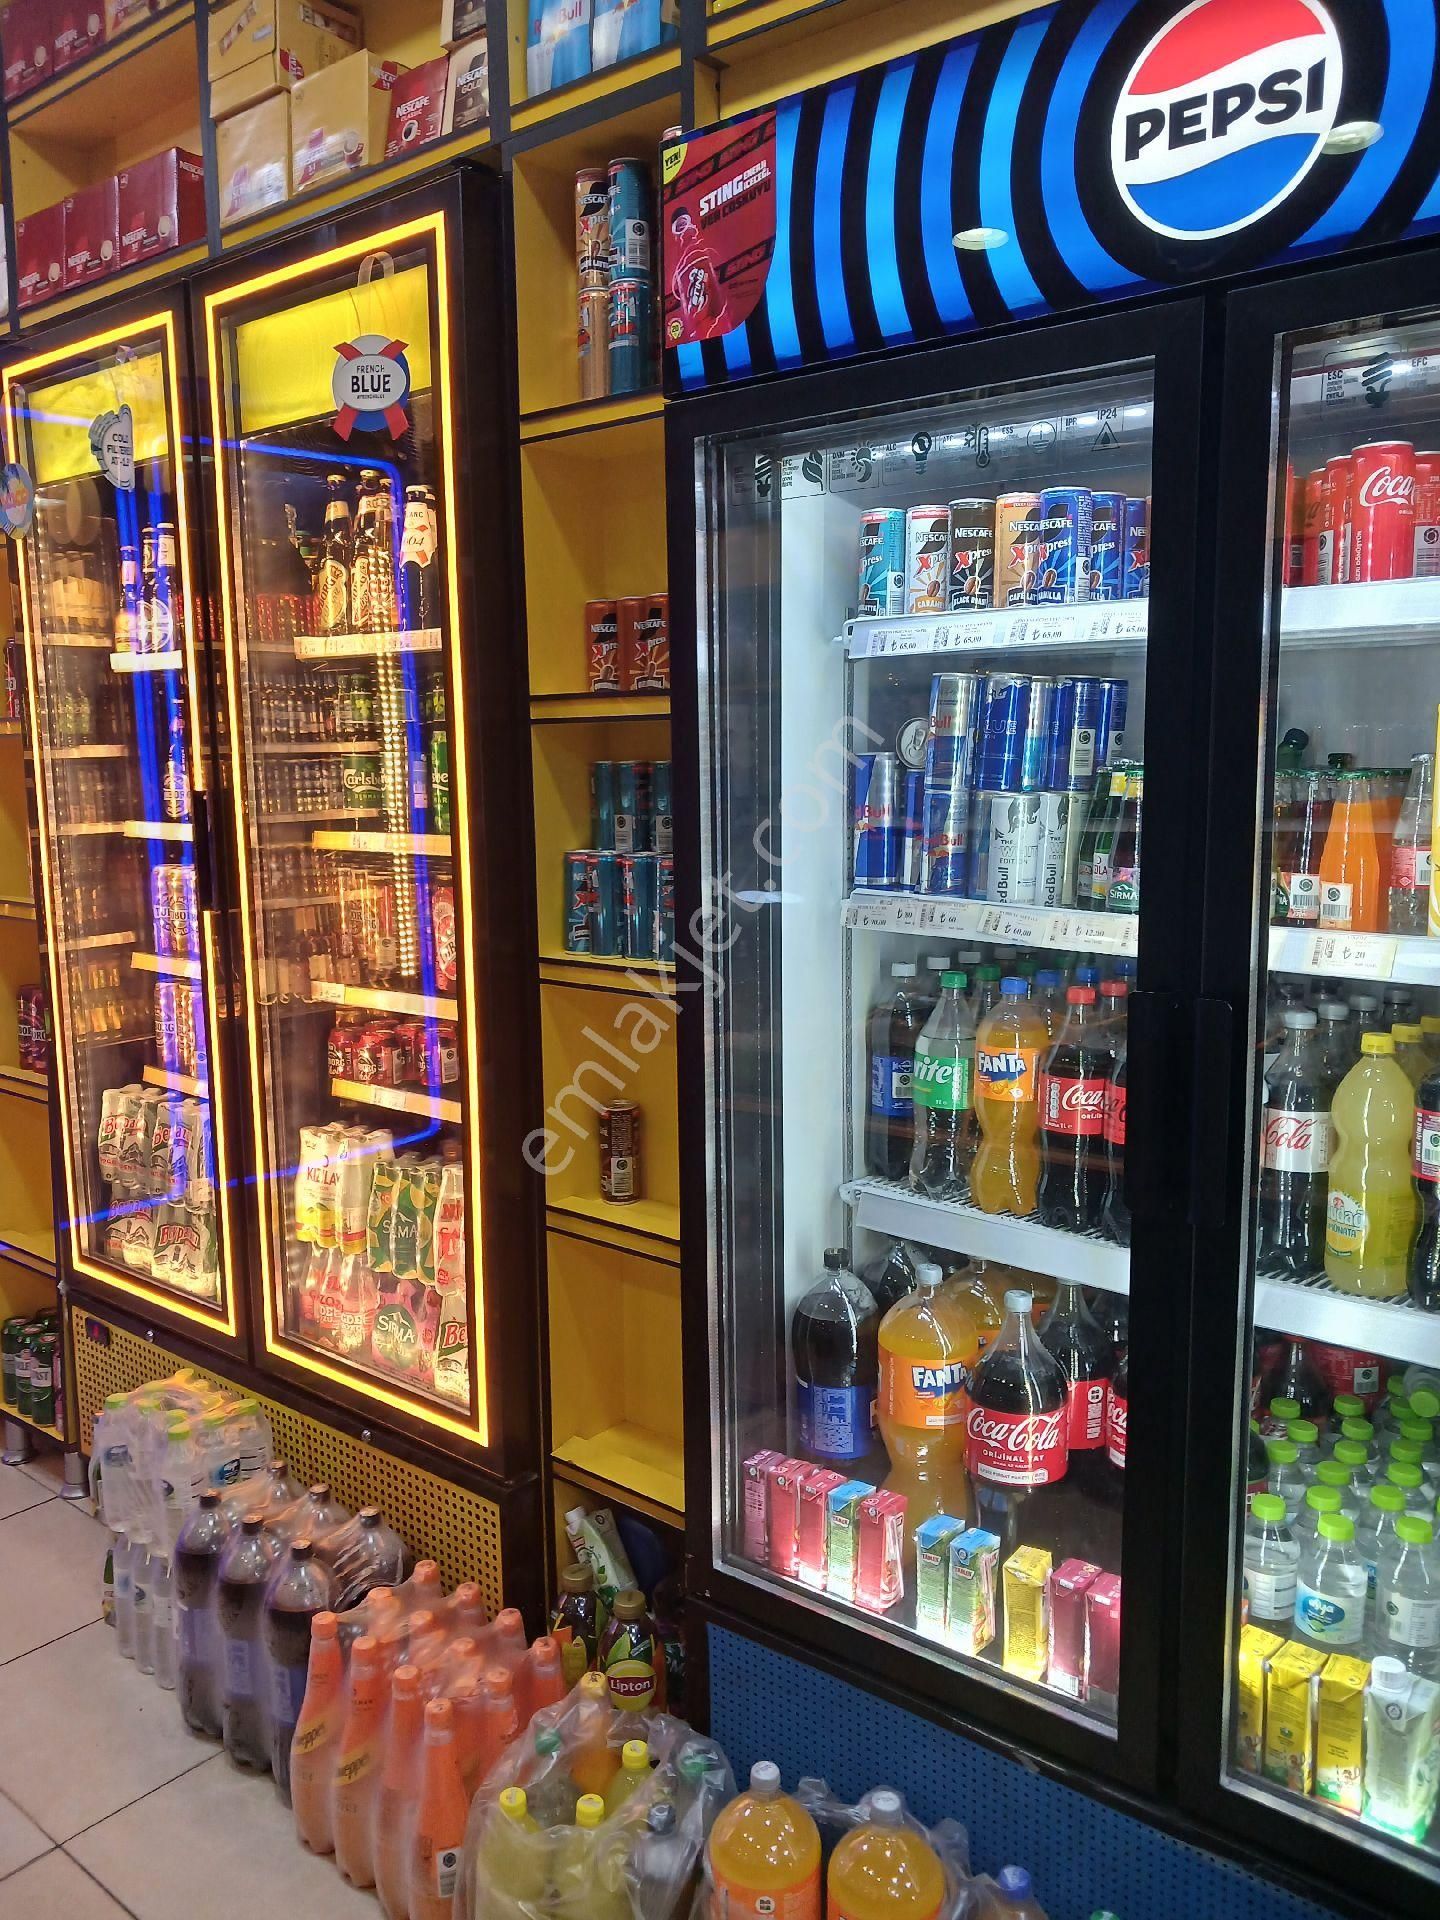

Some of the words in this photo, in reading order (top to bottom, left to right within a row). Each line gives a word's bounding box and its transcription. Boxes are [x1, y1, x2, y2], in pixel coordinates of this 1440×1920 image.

[461, 78, 483, 94] GOLD
[1125, 56, 1327, 163] PEPSI
[699, 175, 744, 217] STING
[356, 364, 385, 374] FRENCH
[1411, 356, 1428, 368] EFC
[351, 374, 391, 393] BLUE
[1327, 369, 1344, 381] ESC
[1097, 407, 1118, 421] IP24
[930, 715, 951, 728] Bull
[977, 1052, 1026, 1074] FANTA
[1264, 1116, 1318, 1151] Cola
[911, 1363, 967, 1389] FANTA
[967, 1407, 1064, 1452] Coca-Cola
[610, 1678, 651, 1693] Lipton
